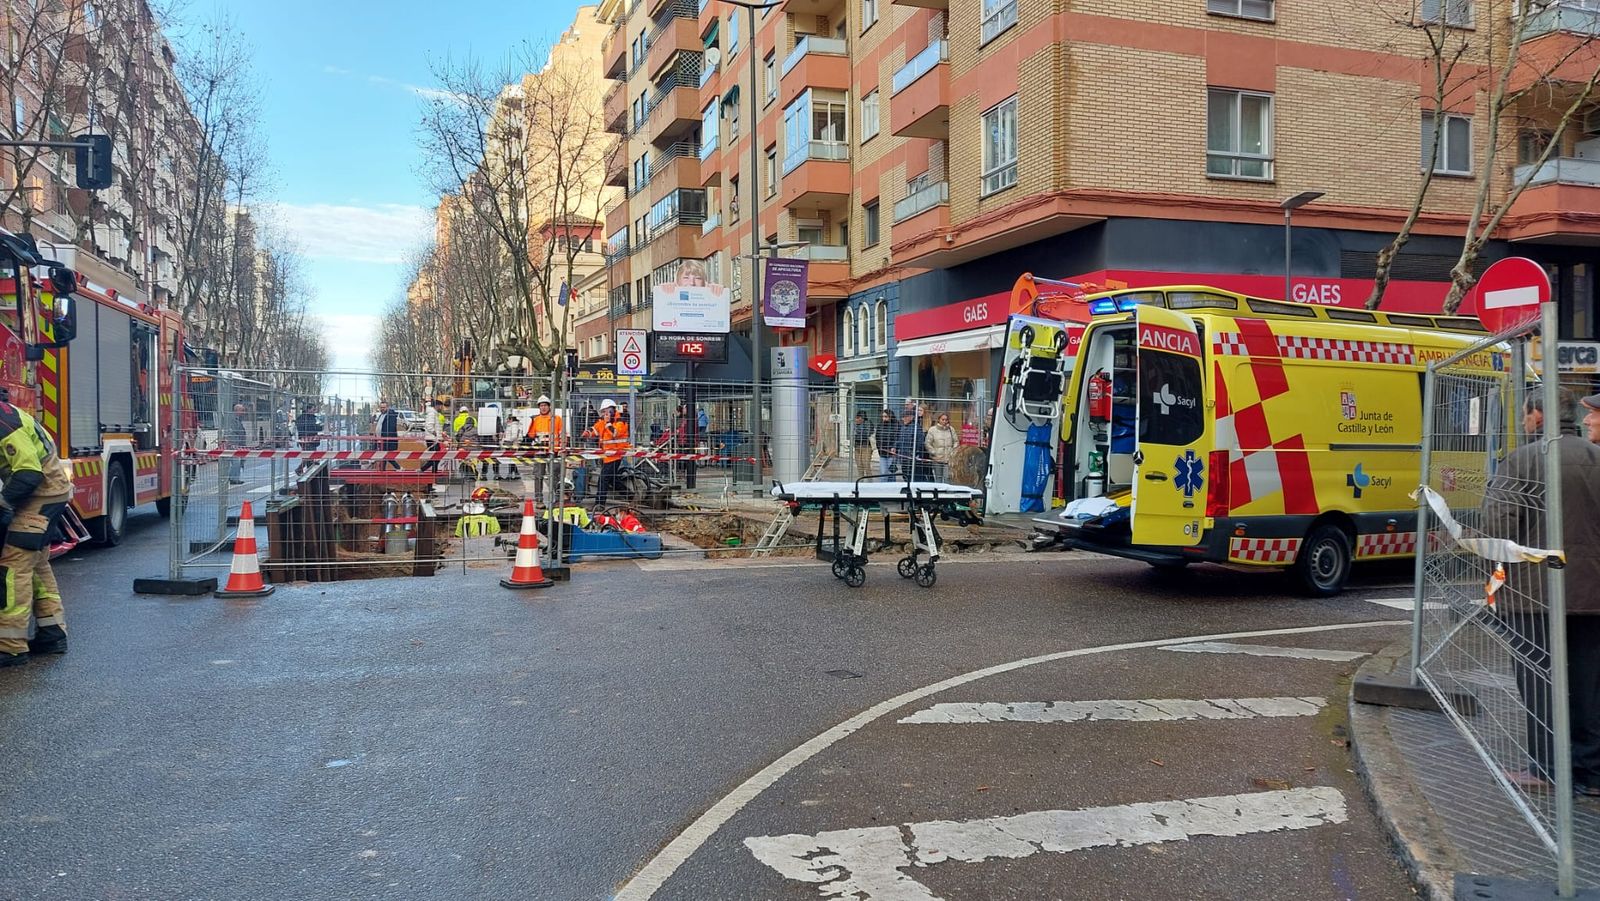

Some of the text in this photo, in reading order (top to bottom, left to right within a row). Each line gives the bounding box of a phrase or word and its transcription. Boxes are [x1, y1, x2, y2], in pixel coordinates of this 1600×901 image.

[1292, 283, 1342, 304] GAES
[963, 302, 988, 323] GAES
[1069, 336, 1082, 345] GA
[1139, 328, 1193, 354] ANCIA
[1418, 349, 1492, 368] AMBUNCIA
[1557, 346, 1598, 364] erca
[596, 372, 614, 380] 120
[1177, 395, 1196, 409] Sacyl
[1359, 410, 1393, 421] Junta de
[1337, 422, 1394, 436] Castilla y León
[1371, 475, 1392, 490] Sacyl
